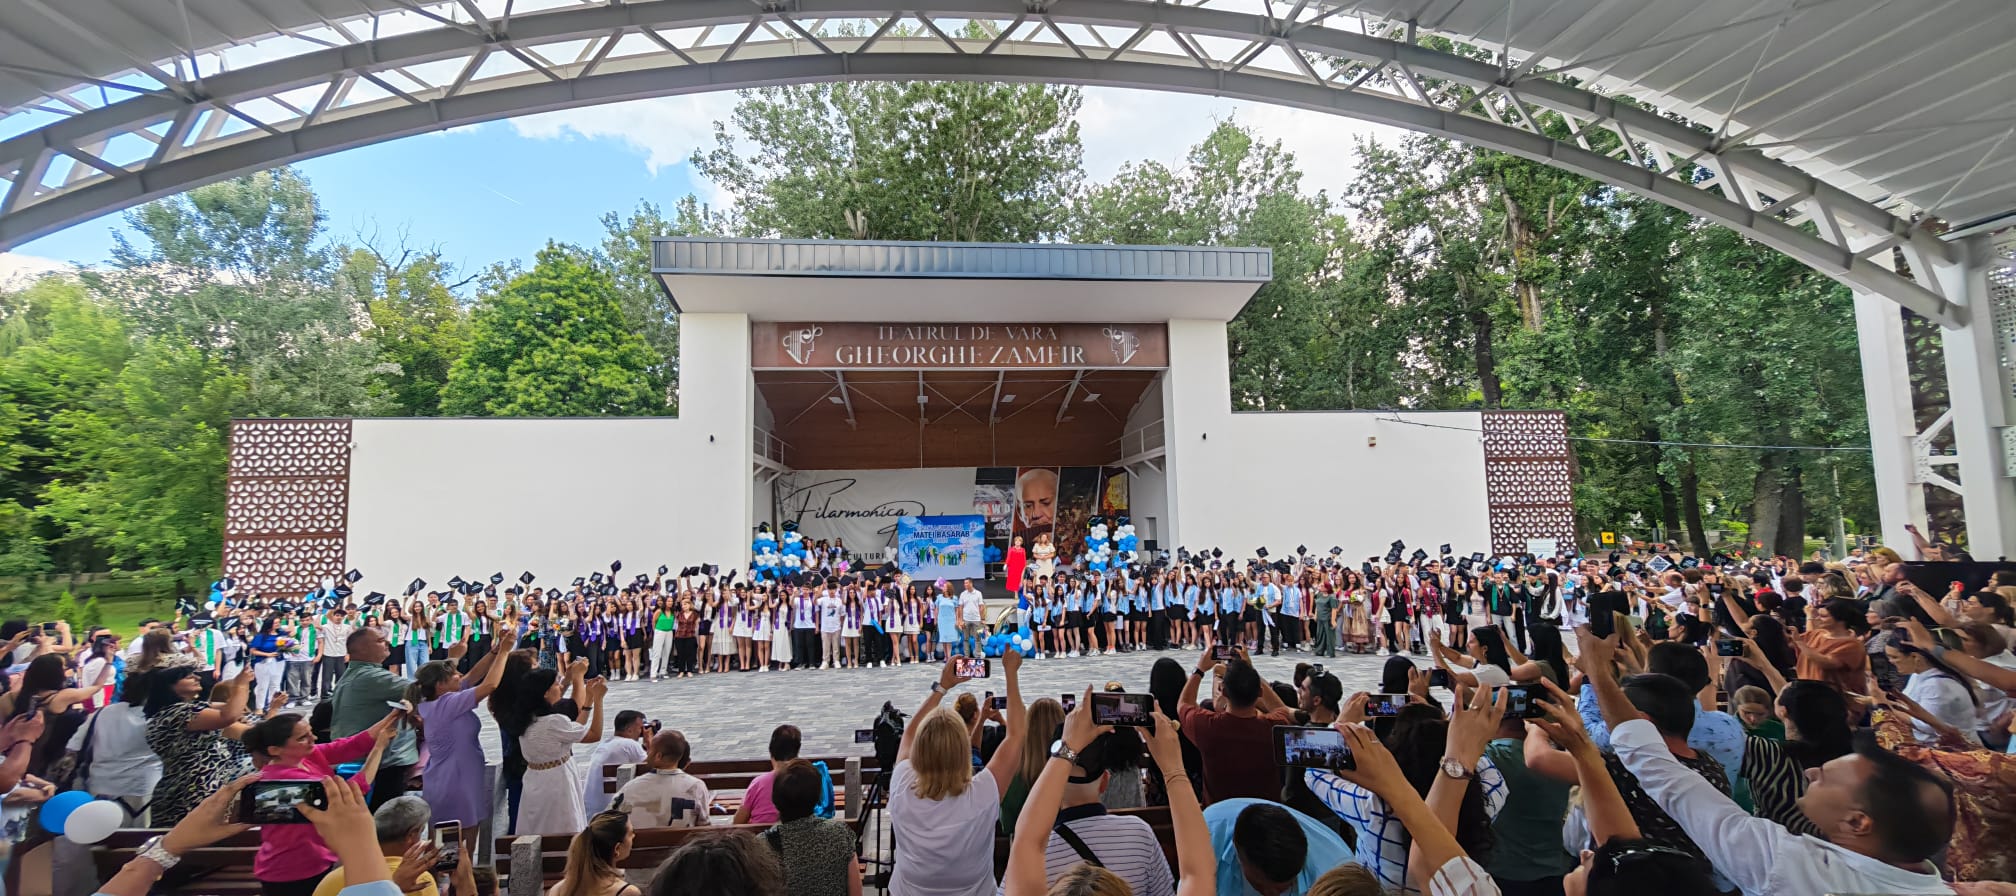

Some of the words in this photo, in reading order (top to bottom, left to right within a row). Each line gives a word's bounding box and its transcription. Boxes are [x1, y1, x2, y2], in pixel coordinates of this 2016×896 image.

[876, 326, 965, 341] TEATRUL
[971, 326, 997, 341] DE
[1005, 326, 1058, 341] VARA
[836, 345, 983, 364] GHEORGHE
[989, 345, 1085, 364] ZAMFIR
[782, 478, 908, 524] Filarmonica
[913, 531, 935, 539] MATEI
[936, 530, 970, 538] BASARAB
